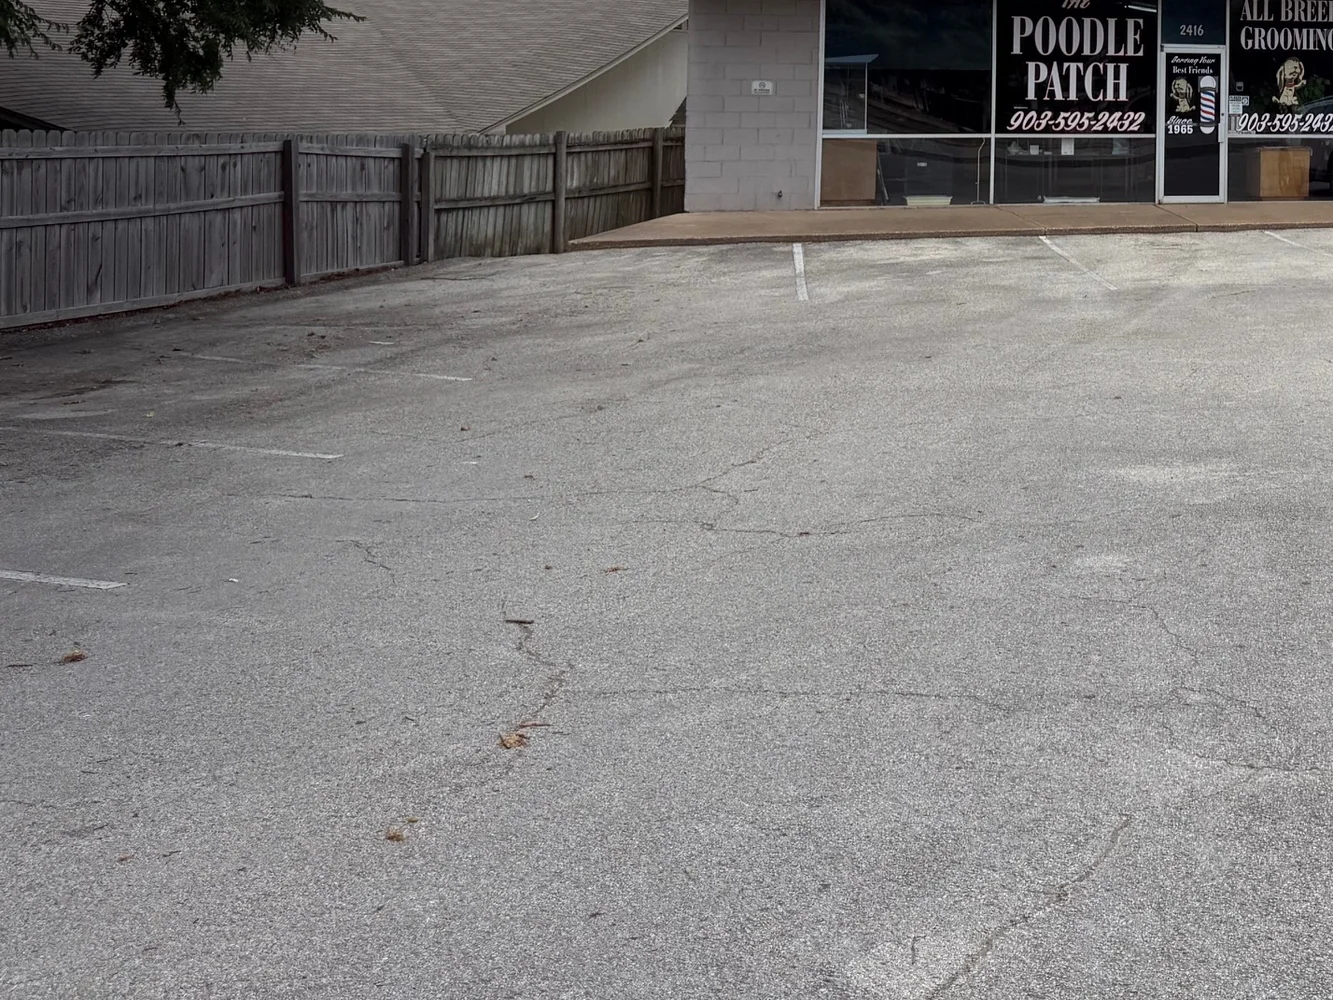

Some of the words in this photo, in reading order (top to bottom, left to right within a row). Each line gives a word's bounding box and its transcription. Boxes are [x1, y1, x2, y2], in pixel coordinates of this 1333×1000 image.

[1010, 16, 1144, 56] POODLE
[1179, 24, 1204, 36] 2416
[1172, 66, 1187, 74] Best
[1188, 66, 1213, 74] Friends
[1025, 61, 1129, 102] PATCH
[1006, 110, 1146, 132] 903-595-2432
[1168, 124, 1193, 134] 1965
